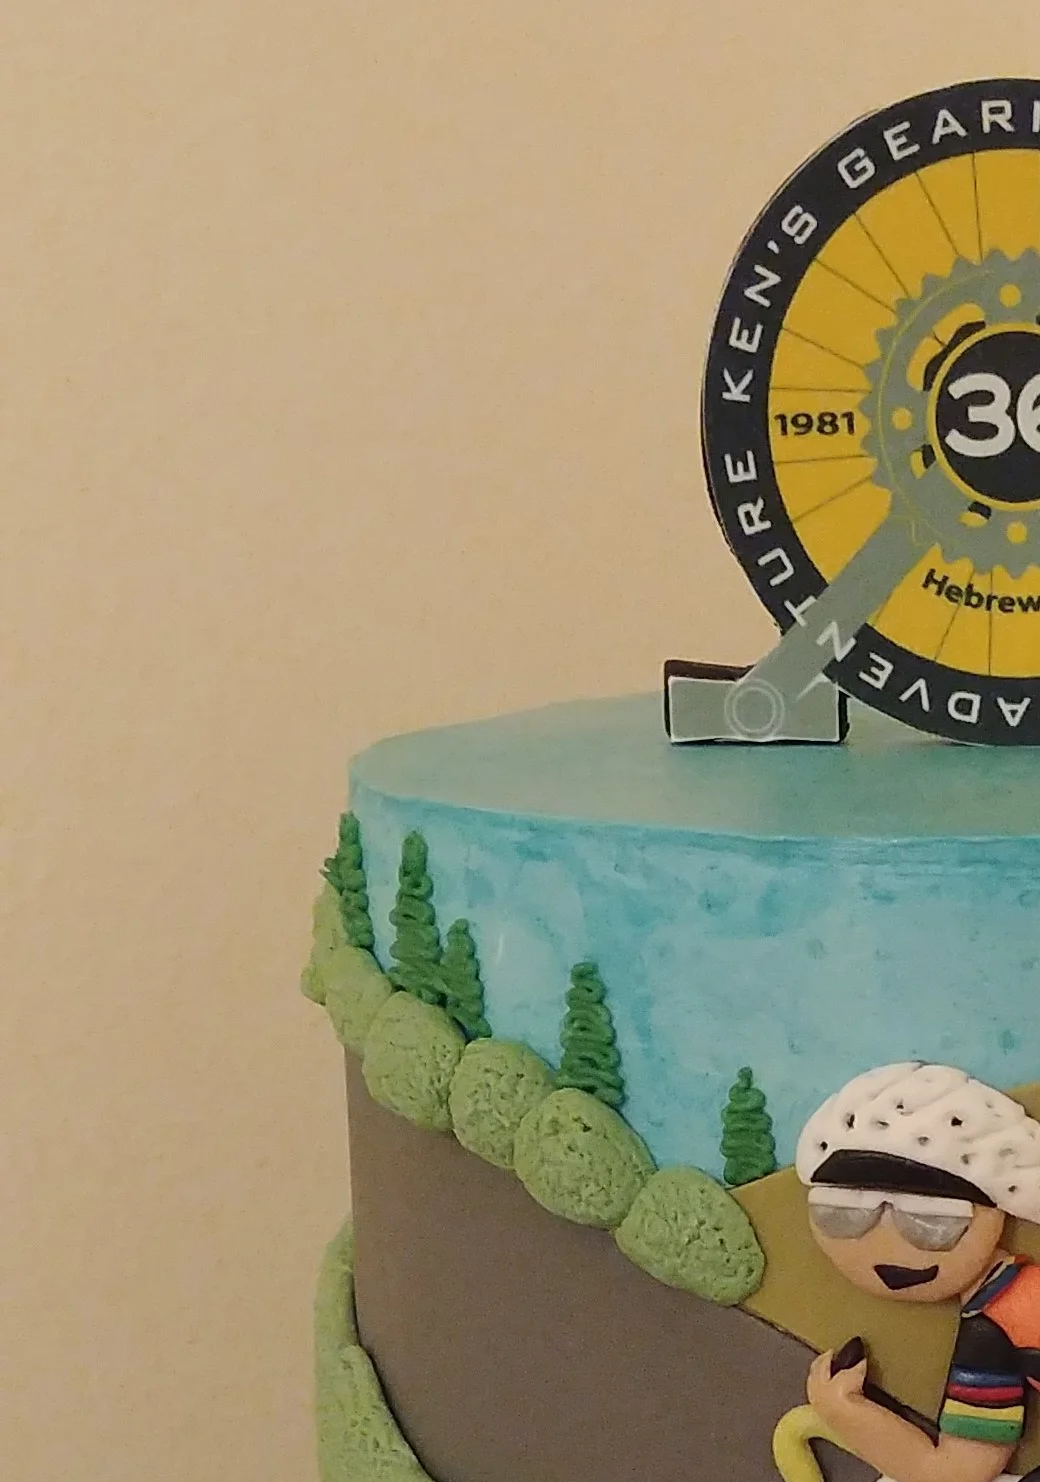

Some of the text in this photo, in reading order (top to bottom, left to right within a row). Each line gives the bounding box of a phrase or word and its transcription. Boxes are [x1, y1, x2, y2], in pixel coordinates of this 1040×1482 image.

[721, 205, 818, 403] KEN'S
[773, 410, 856, 437] 1981
[723, 450, 1031, 728] ADVENTURE
